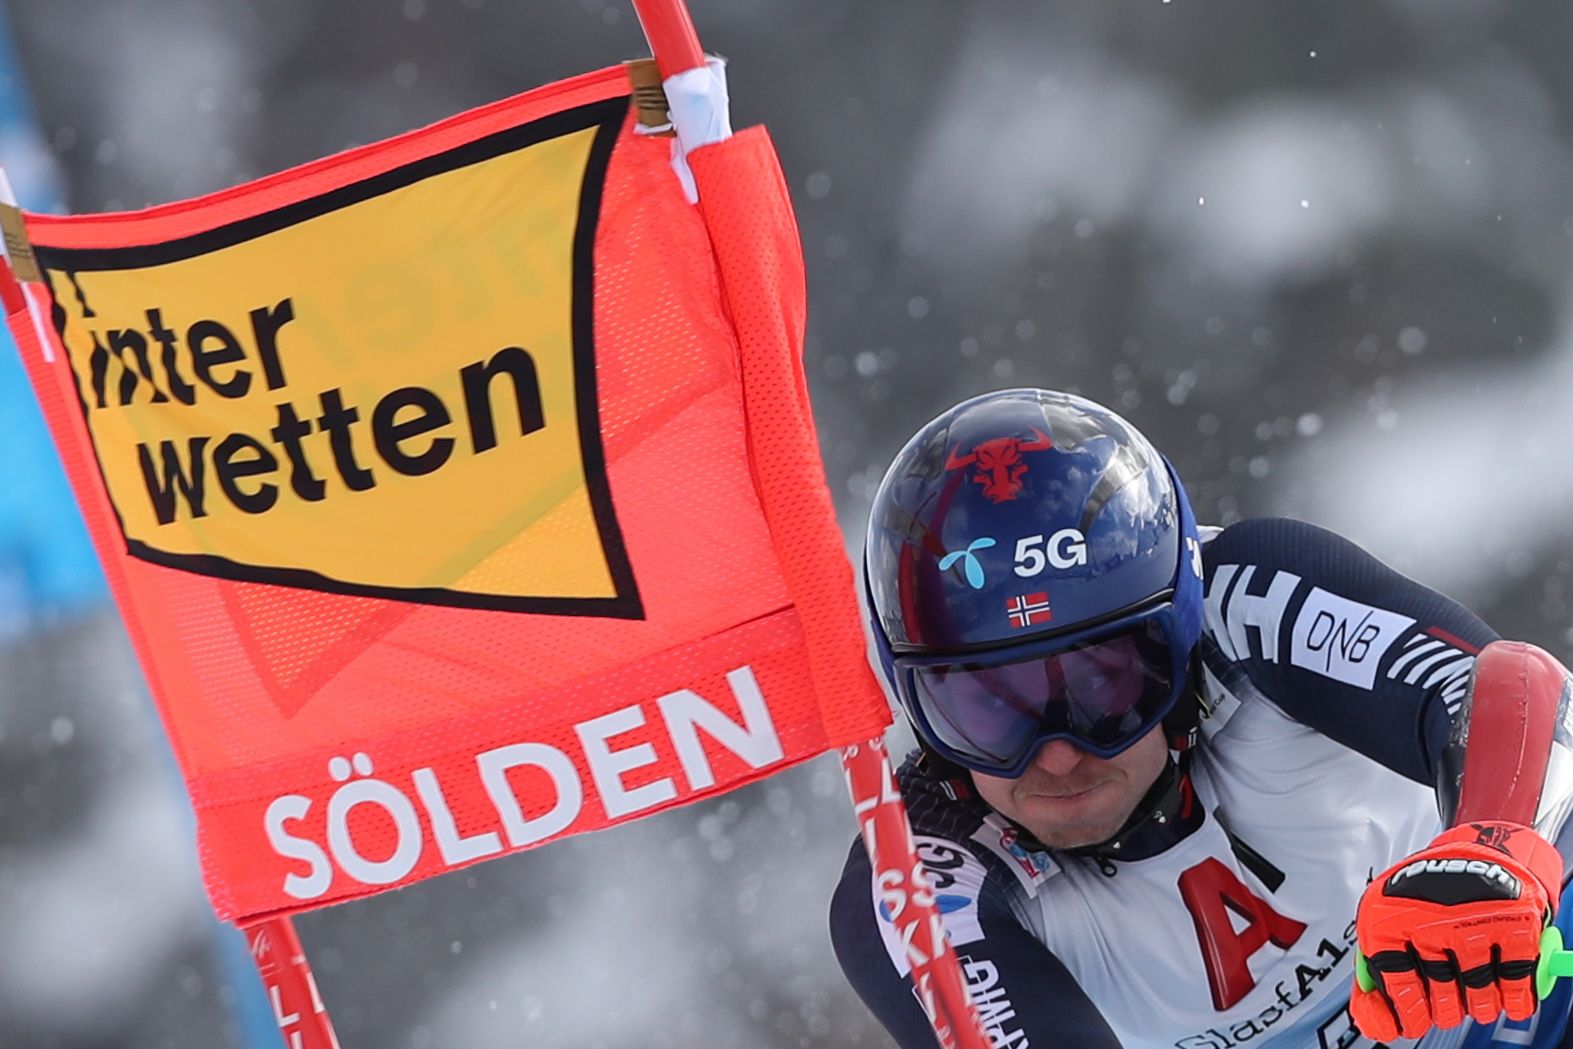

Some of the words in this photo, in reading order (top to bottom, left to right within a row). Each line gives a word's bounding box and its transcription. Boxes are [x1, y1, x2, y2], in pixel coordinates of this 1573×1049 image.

[136, 346, 547, 526] wetten
[1013, 528, 1088, 577] 5G
[1306, 610, 1380, 672] DNB
[264, 665, 785, 899] SÖLDEN
